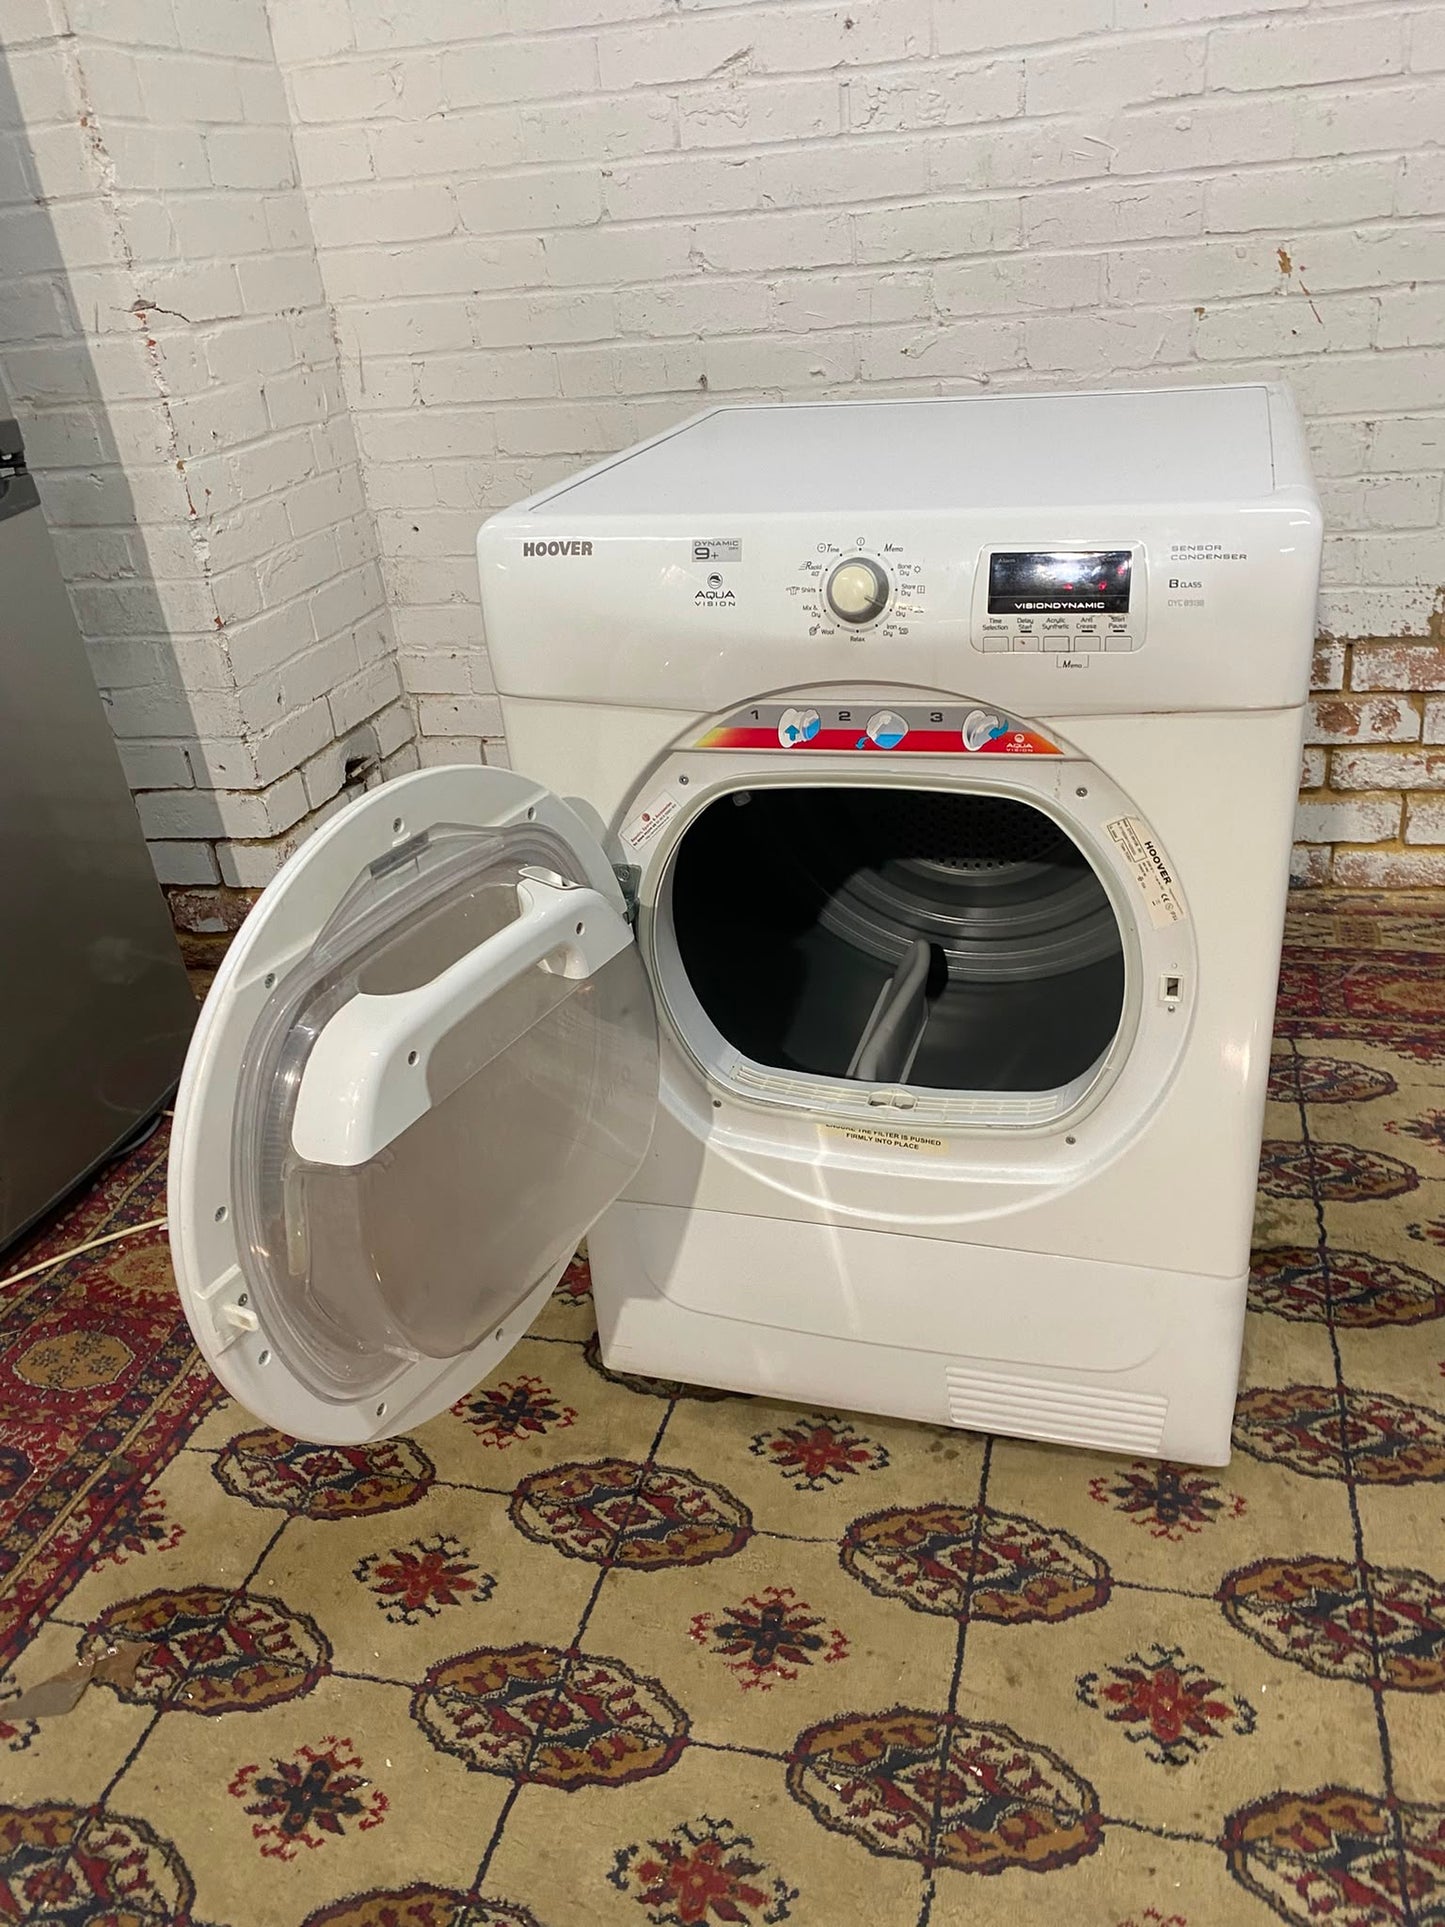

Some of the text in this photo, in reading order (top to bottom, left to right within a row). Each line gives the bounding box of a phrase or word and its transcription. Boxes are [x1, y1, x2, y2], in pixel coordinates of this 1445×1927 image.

[523, 541, 593, 556] HOOVER
[826, 543, 840, 552] Time
[883, 543, 904, 552] Memo
[694, 547, 719, 560] 9+
[1169, 578, 1179, 588] B
[694, 590, 736, 600] AQUA
[901, 589, 911, 597] Dry
[882, 629, 893, 637] Dry
[1062, 660, 1083, 669] Memo
[750, 709, 943, 723] 1 2 3
[1144, 841, 1172, 885] HOOVER
[846, 1133, 919, 1150] FIRMLY INTO PLACE
[874, 1131, 900, 1139] FILTER
[910, 1136, 942, 1146] PUSHED
